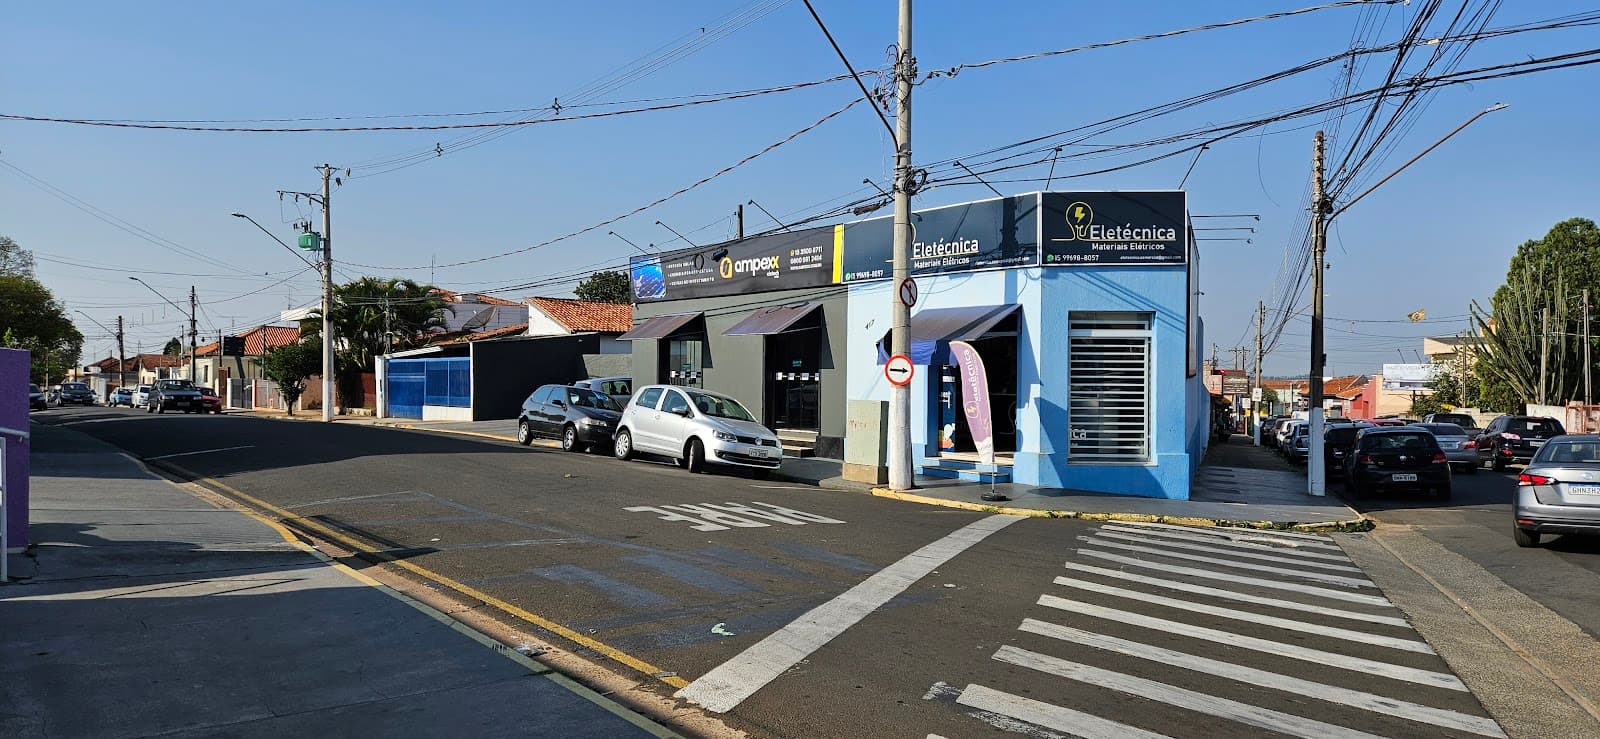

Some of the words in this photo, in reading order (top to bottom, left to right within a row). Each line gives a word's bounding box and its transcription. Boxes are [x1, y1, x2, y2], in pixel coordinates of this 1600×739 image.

[1089, 223, 1176, 240] Eletécnica
[913, 237, 979, 258] Eletécnica
[1092, 243, 1129, 251] Materiais
[1130, 243, 1166, 251] Elétricos
[735, 256, 780, 277] ampexx
[914, 259, 941, 269] Materiais
[942, 256, 970, 266] Elétricos
[622, 501, 847, 532] PARE
